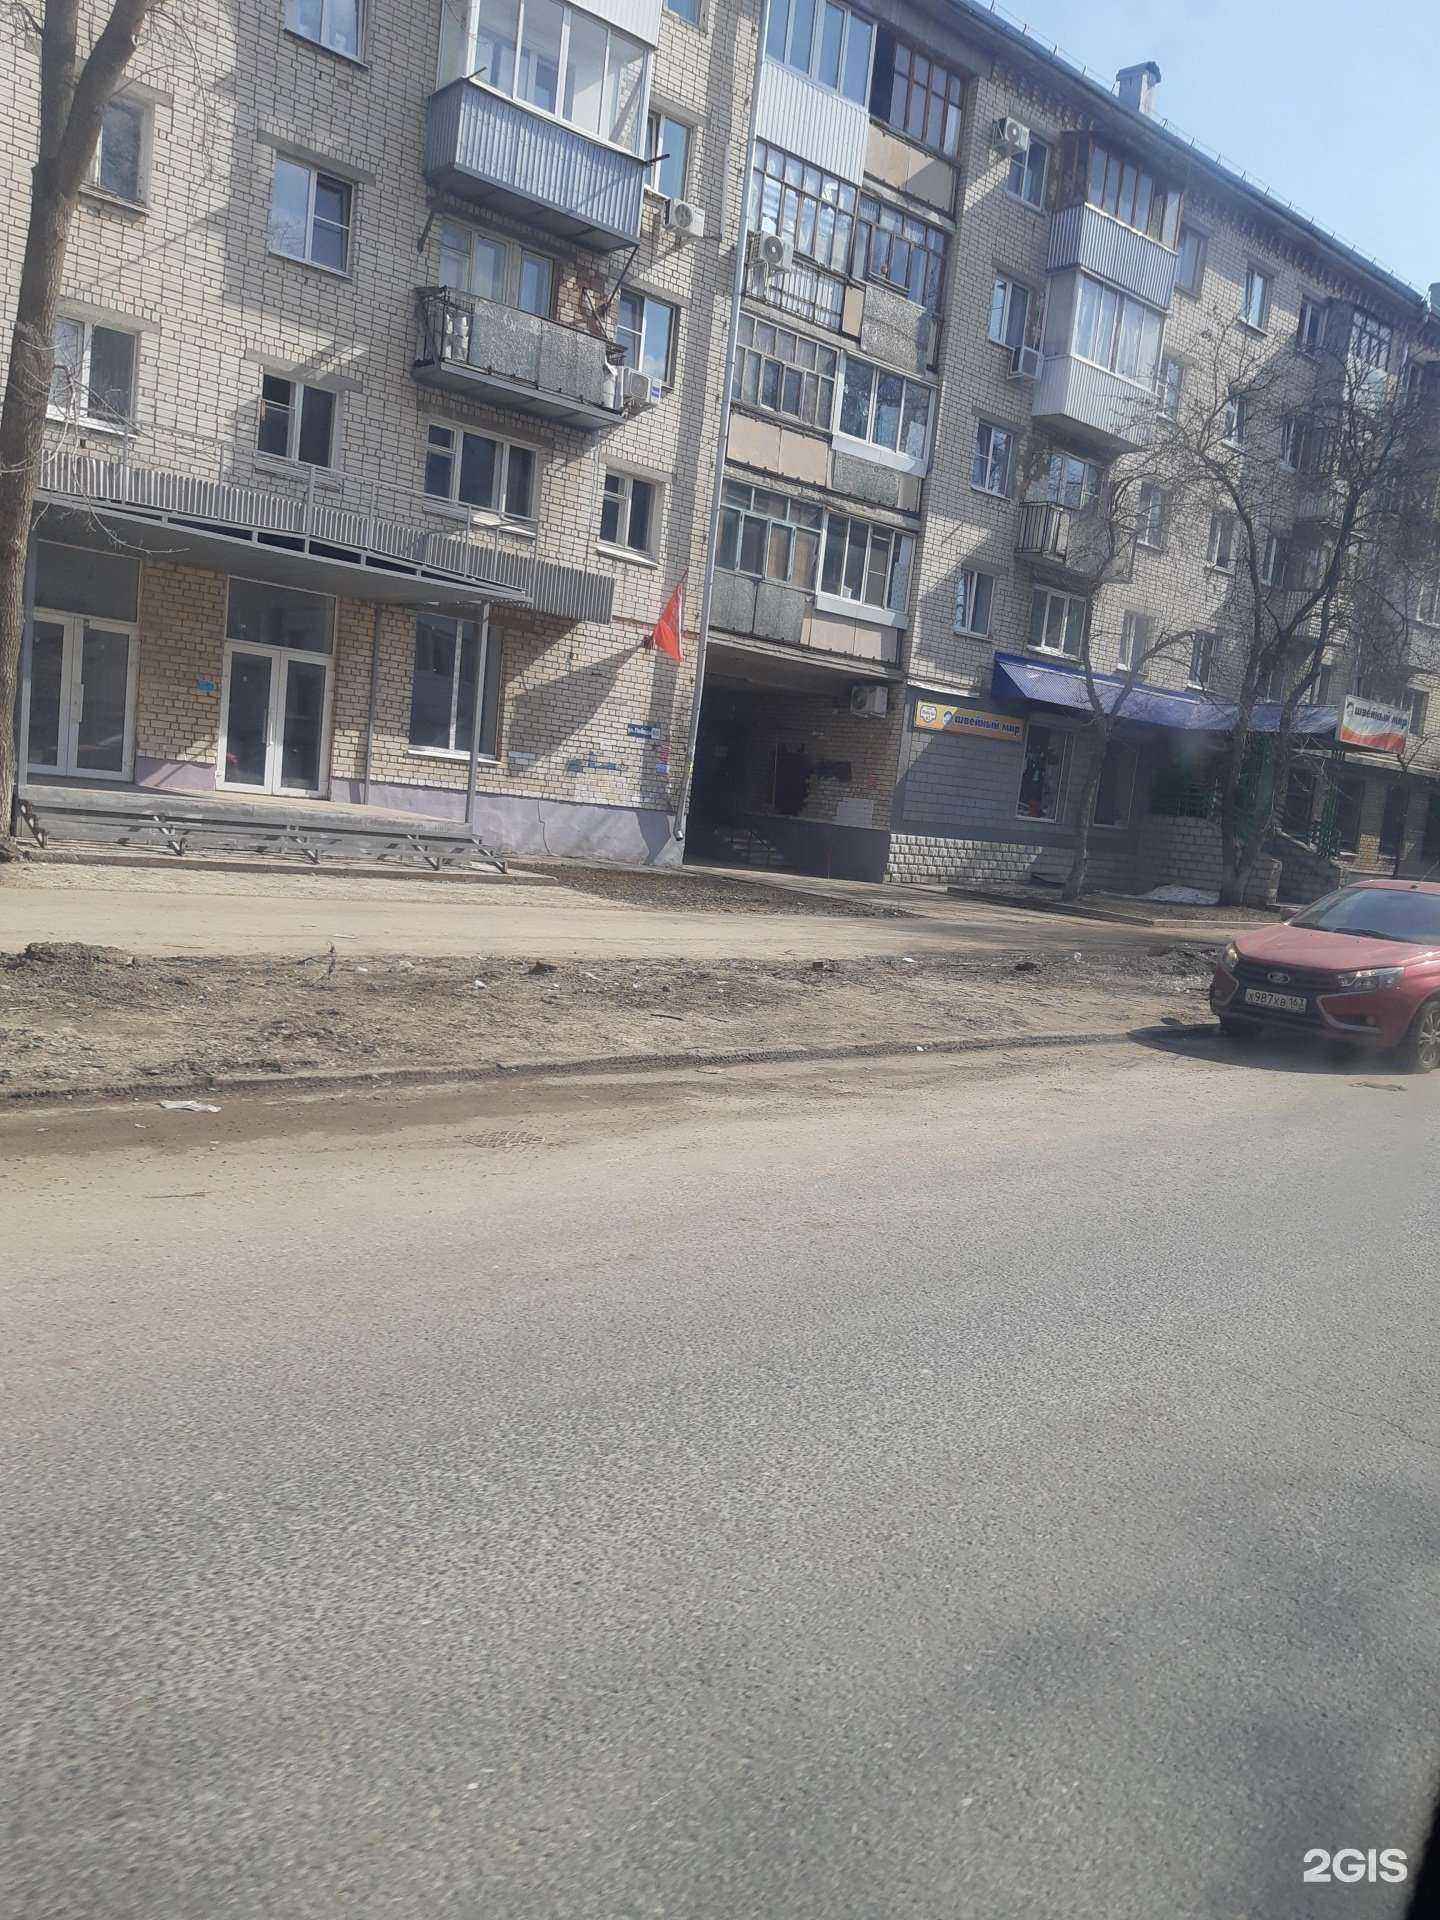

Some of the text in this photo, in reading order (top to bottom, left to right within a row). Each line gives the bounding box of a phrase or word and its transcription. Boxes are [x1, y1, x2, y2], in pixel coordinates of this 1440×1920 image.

[1354, 706, 1392, 722] швейный
[954, 715, 1020, 736] швейный мир
